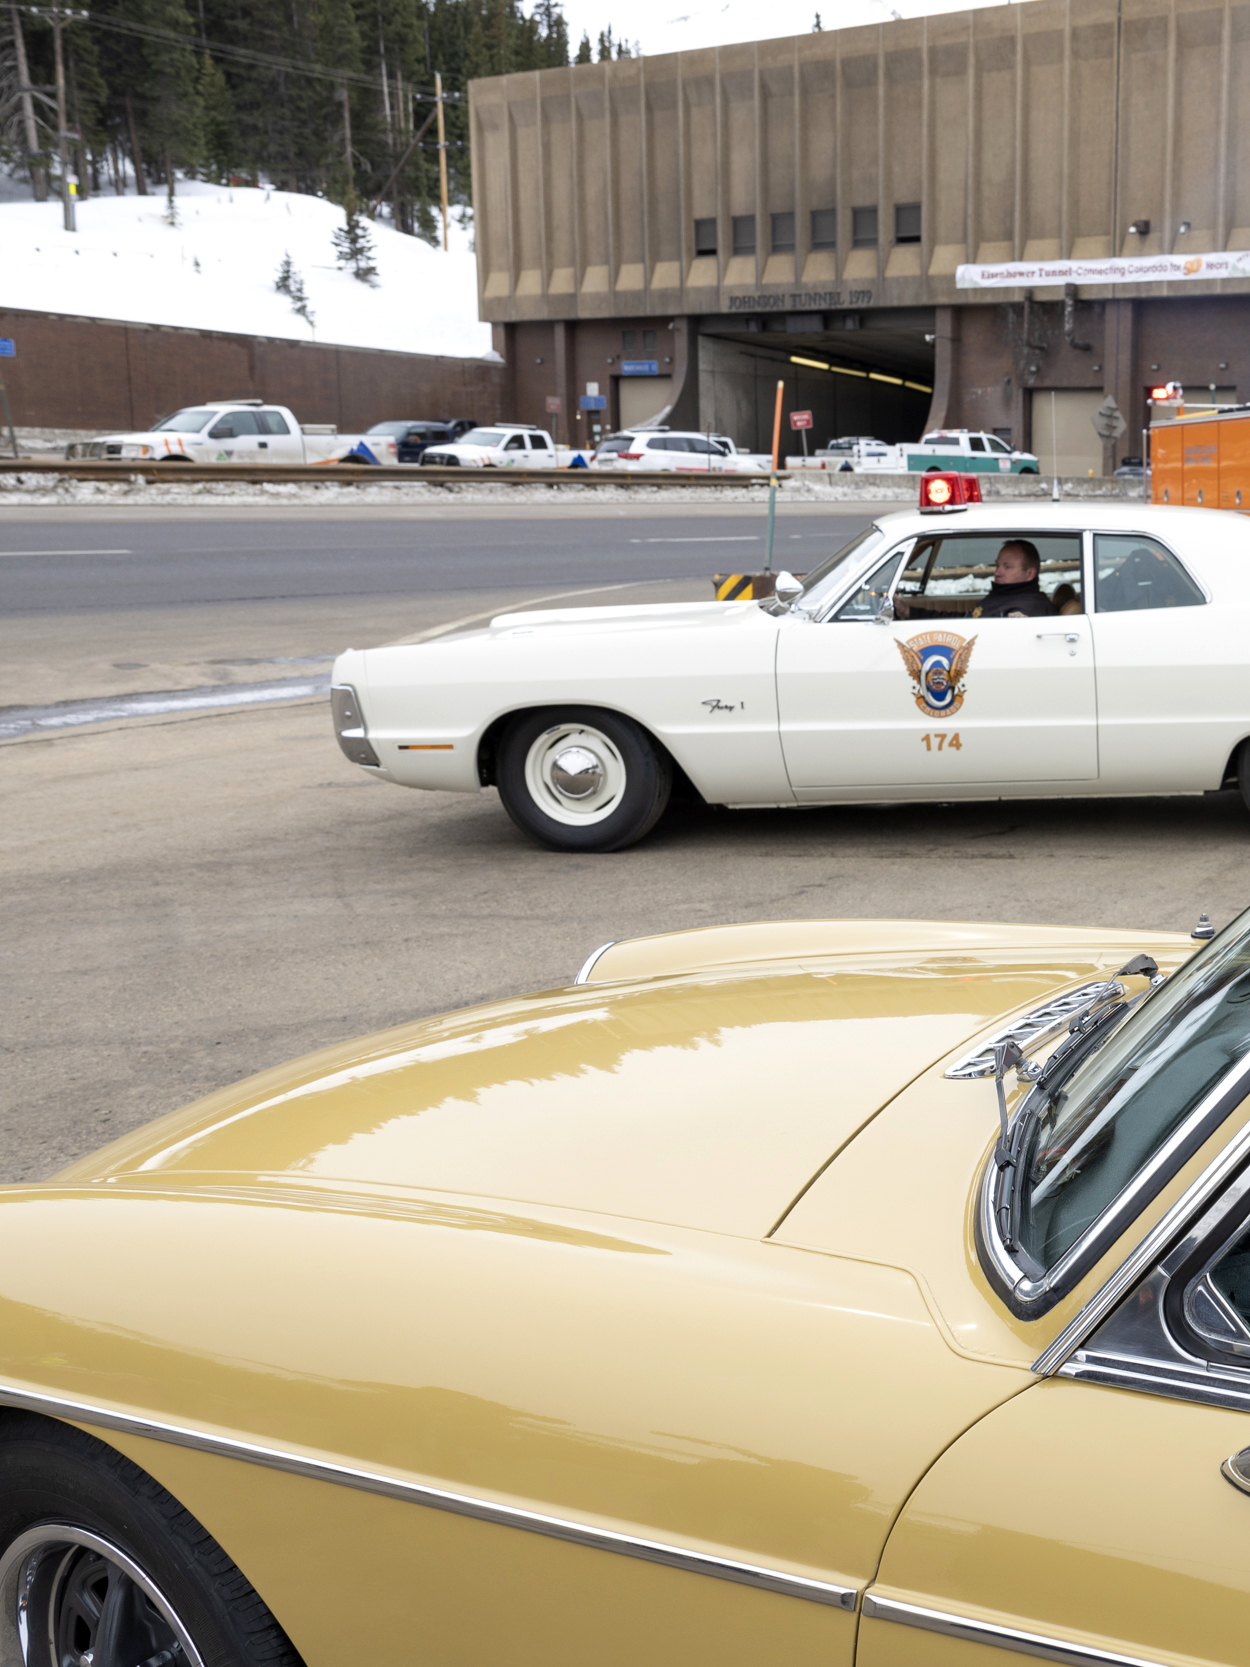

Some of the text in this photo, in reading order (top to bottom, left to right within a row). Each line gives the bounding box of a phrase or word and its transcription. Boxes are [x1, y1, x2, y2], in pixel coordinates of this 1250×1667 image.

[981, 268, 1036, 280] Eisenhower
[1127, 263, 1168, 276] Colorado
[1184, 257, 1202, 276] 50
[728, 290, 872, 310] JOHNSON TUNNEL 1979
[909, 632, 961, 651] STATE PATROL
[919, 701, 961, 718] COLORADO
[921, 733, 962, 751] 174
